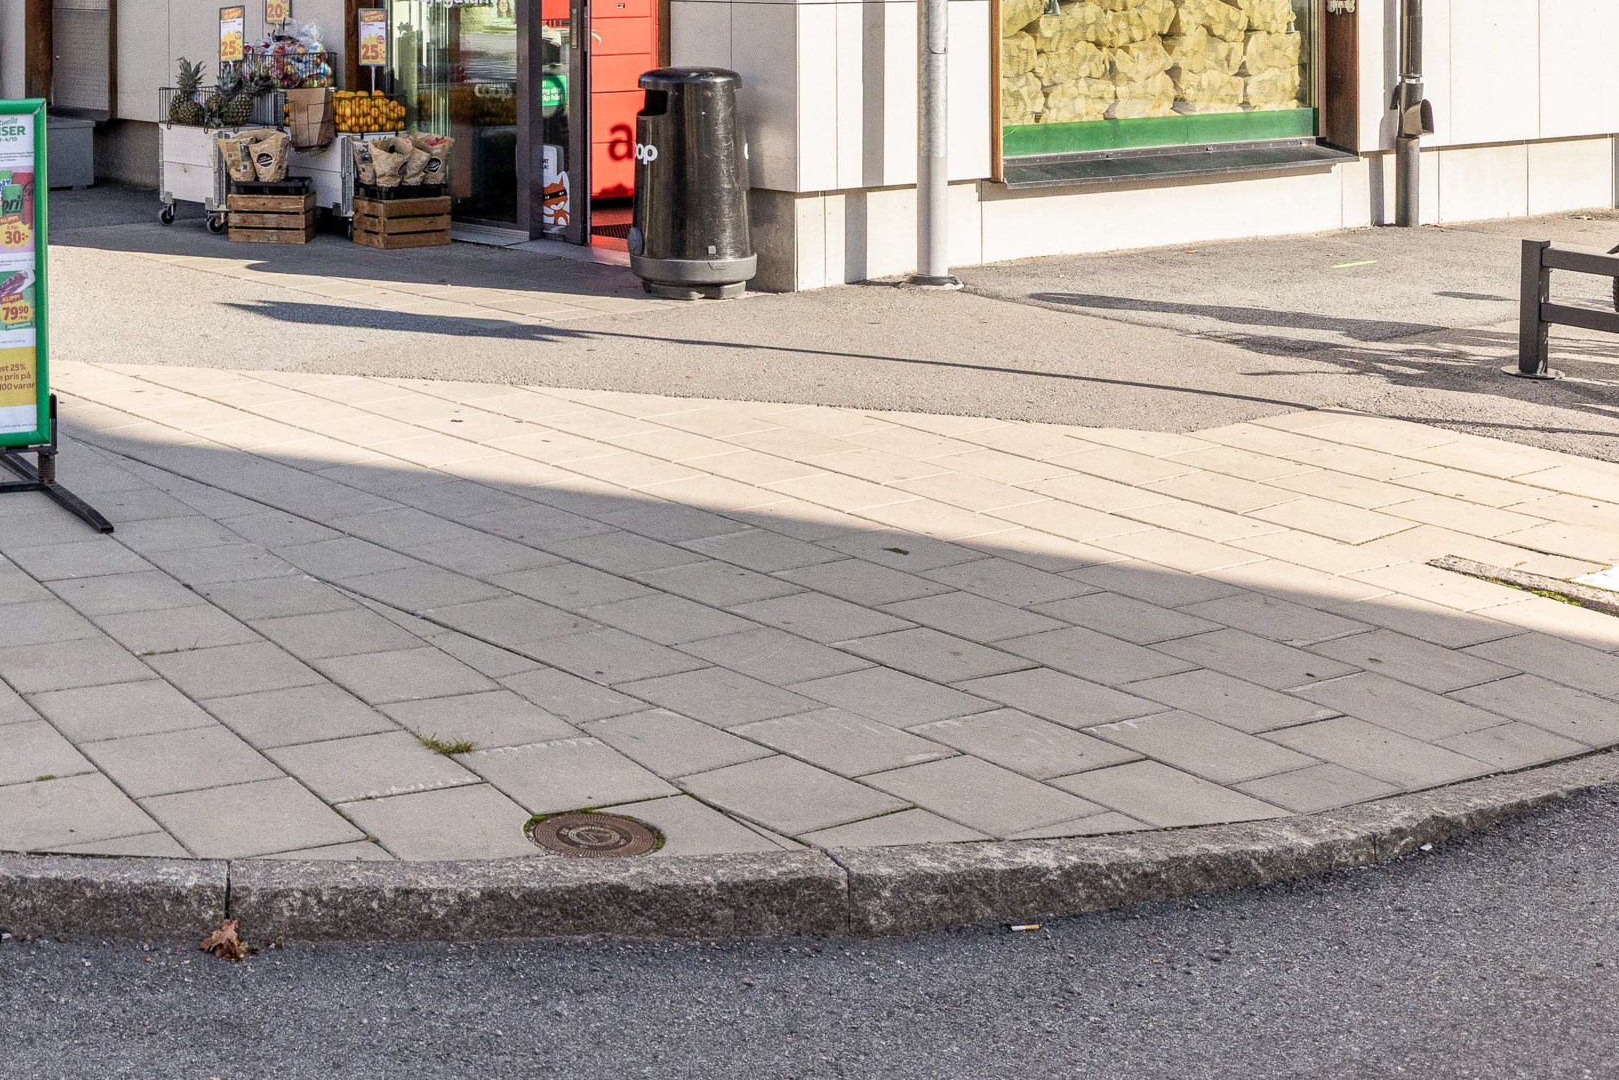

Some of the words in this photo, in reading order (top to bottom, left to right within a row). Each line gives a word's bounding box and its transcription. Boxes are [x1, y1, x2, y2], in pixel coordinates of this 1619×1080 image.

[10, 363, 26, 371] 25%
[4, 372, 20, 382] pris
[20, 371, 32, 381] på
[14, 382, 35, 390] varor
